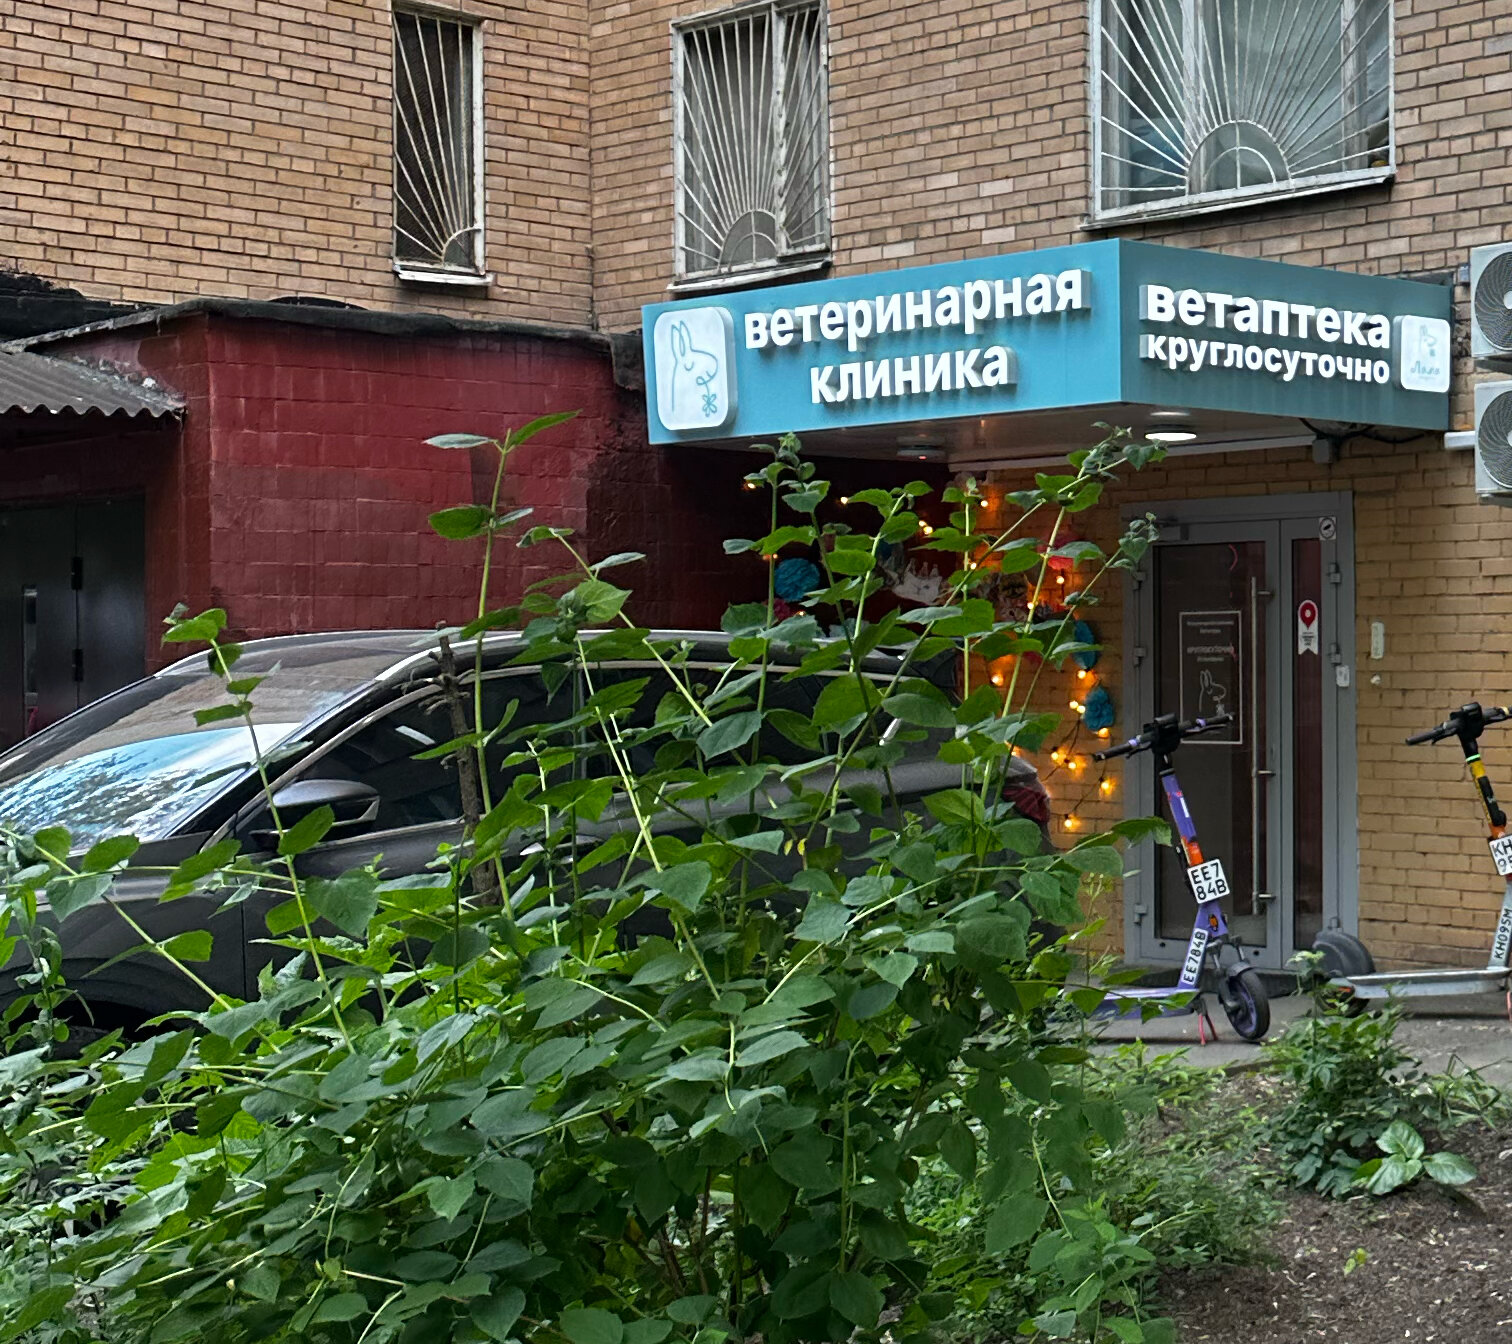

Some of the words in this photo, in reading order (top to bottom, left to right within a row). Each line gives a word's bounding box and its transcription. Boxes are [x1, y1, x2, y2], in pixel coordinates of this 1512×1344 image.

[744, 269, 1084, 352] ветеринарная
[1146, 284, 1391, 349] ветаптека
[810, 344, 1009, 404] клиника
[1146, 333, 1391, 385] круглосуточно
